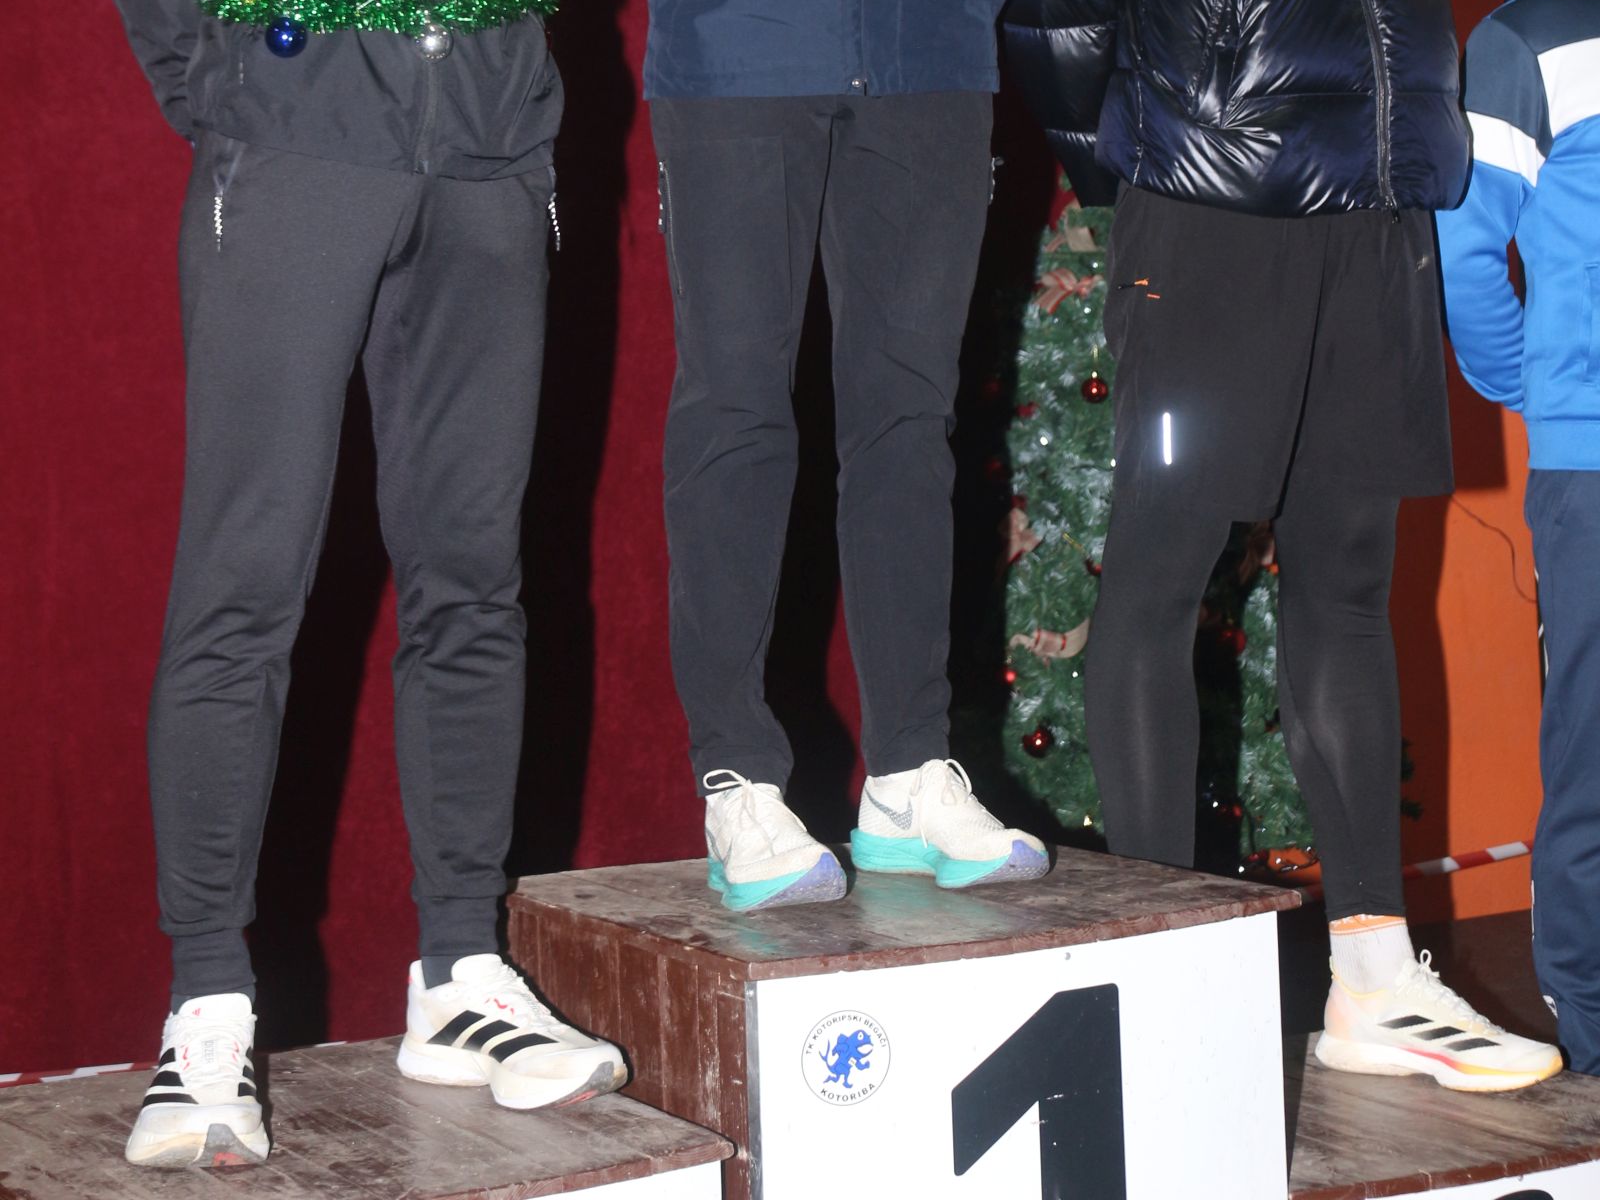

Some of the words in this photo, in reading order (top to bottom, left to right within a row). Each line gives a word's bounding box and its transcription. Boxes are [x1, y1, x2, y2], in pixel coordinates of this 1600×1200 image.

[806, 1044, 814, 1054] TK
[813, 1015, 861, 1040] KOTORIPSKI
[820, 1083, 875, 1101] KOTORIBA
[952, 983, 1127, 1200] 1
